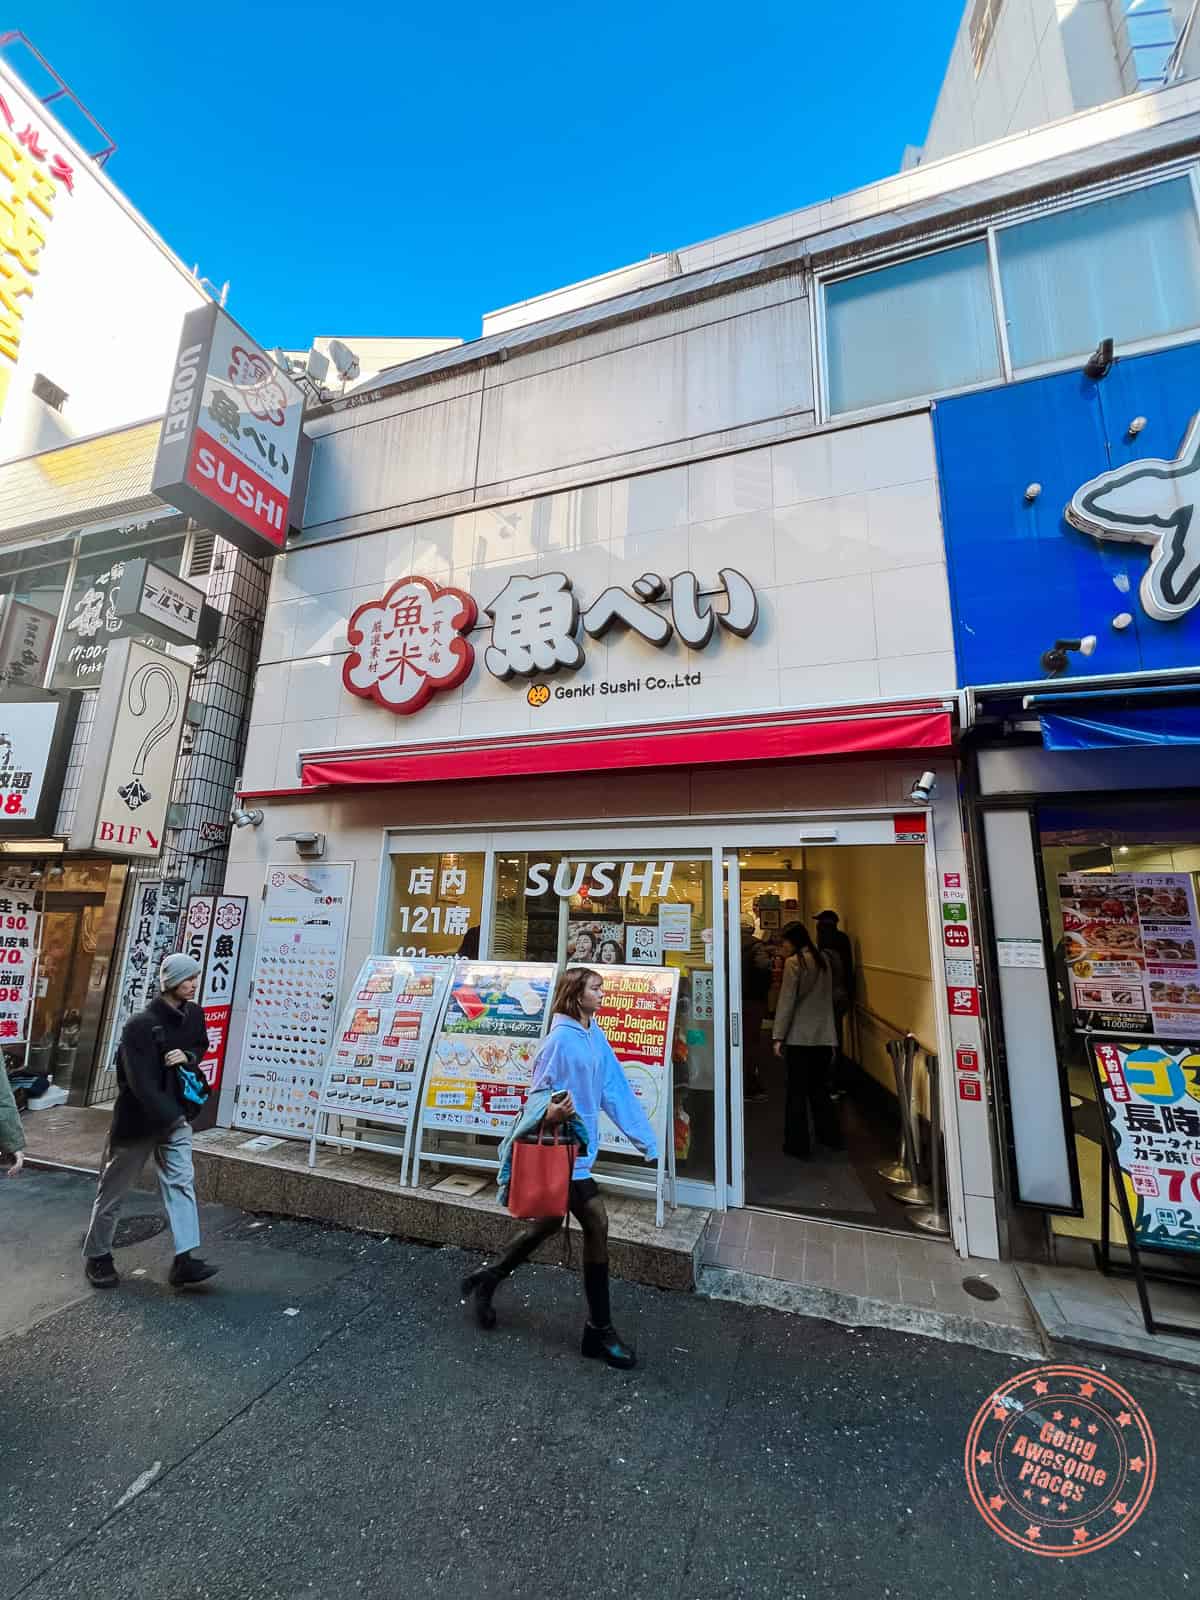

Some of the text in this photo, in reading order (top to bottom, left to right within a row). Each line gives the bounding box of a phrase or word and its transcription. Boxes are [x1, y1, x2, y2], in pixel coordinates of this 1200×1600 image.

[164, 344, 202, 445] UOBEI
[196, 448, 284, 530] SUSHI
[484, 567, 758, 680] 魚べい
[554, 671, 702, 699] Genki Sushi Co.,Ltd
[99, 821, 142, 845] B1F
[407, 865, 467, 897] 店内
[523, 862, 675, 897] SUSHI
[398, 904, 471, 936] 121席
[210, 934, 234, 993] 魚べい
[627, 1032, 665, 1047] square
